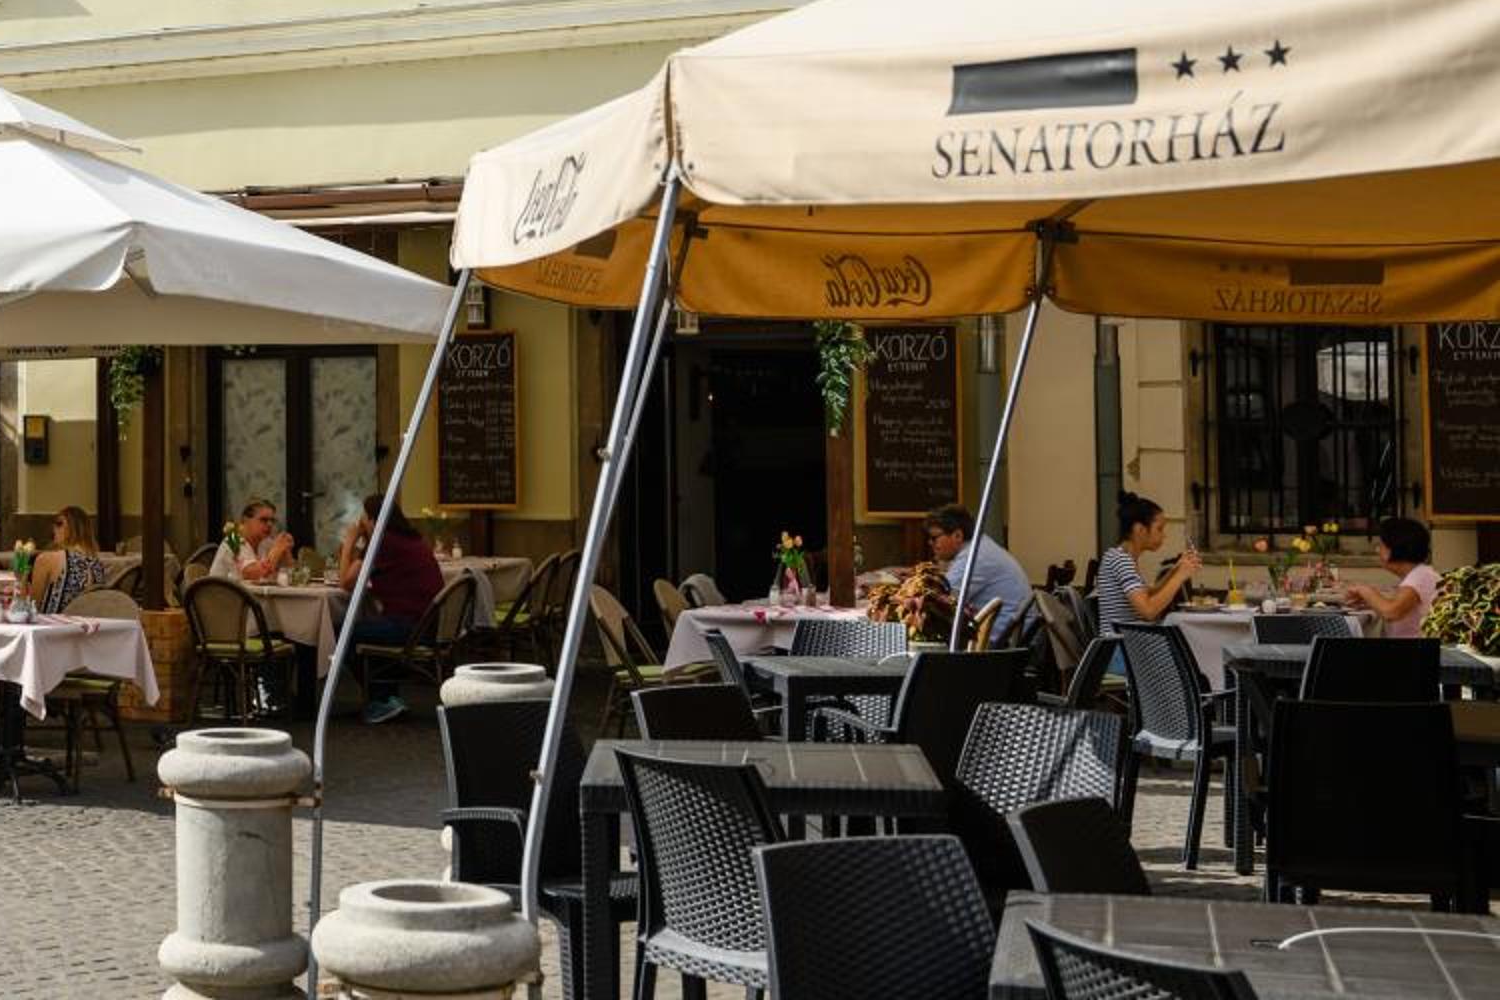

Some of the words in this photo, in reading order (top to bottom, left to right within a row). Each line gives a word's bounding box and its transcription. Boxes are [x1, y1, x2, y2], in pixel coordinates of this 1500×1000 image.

[932, 91, 1286, 179] SENATORHÁZ
[446, 338, 512, 369] KORZÓ
[875, 329, 947, 361] KORZÓ
